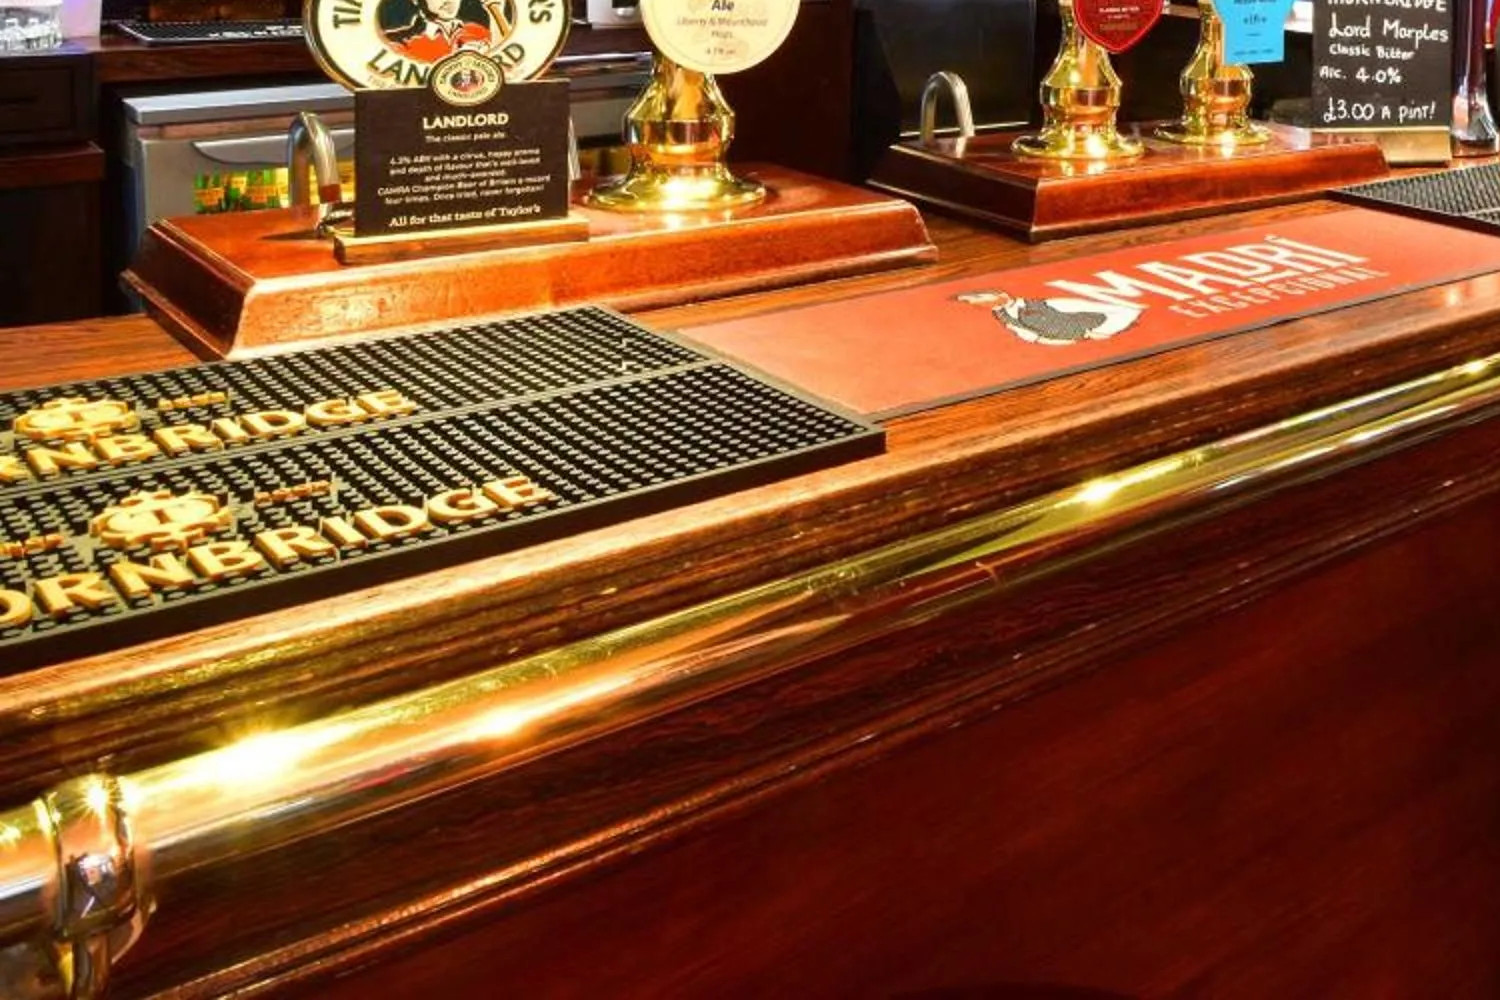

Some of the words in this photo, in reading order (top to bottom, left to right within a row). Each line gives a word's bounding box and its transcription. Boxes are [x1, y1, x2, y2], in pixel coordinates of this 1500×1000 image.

[711, 0, 735, 11] Ale
[1329, 12, 1371, 38] Lord
[1382, 18, 1449, 49] Marples
[1329, 43, 1370, 57] Classic
[1376, 45, 1415, 60] Bitter
[367, 42, 525, 86] LANRD
[1355, 66, 1402, 84] 4.0%
[1323, 97, 1374, 123] £3.00
[422, 113, 509, 130] LANDLORD
[389, 216, 407, 228] All
[409, 214, 426, 226] for
[429, 212, 451, 223] that
[484, 208, 498, 218] of
